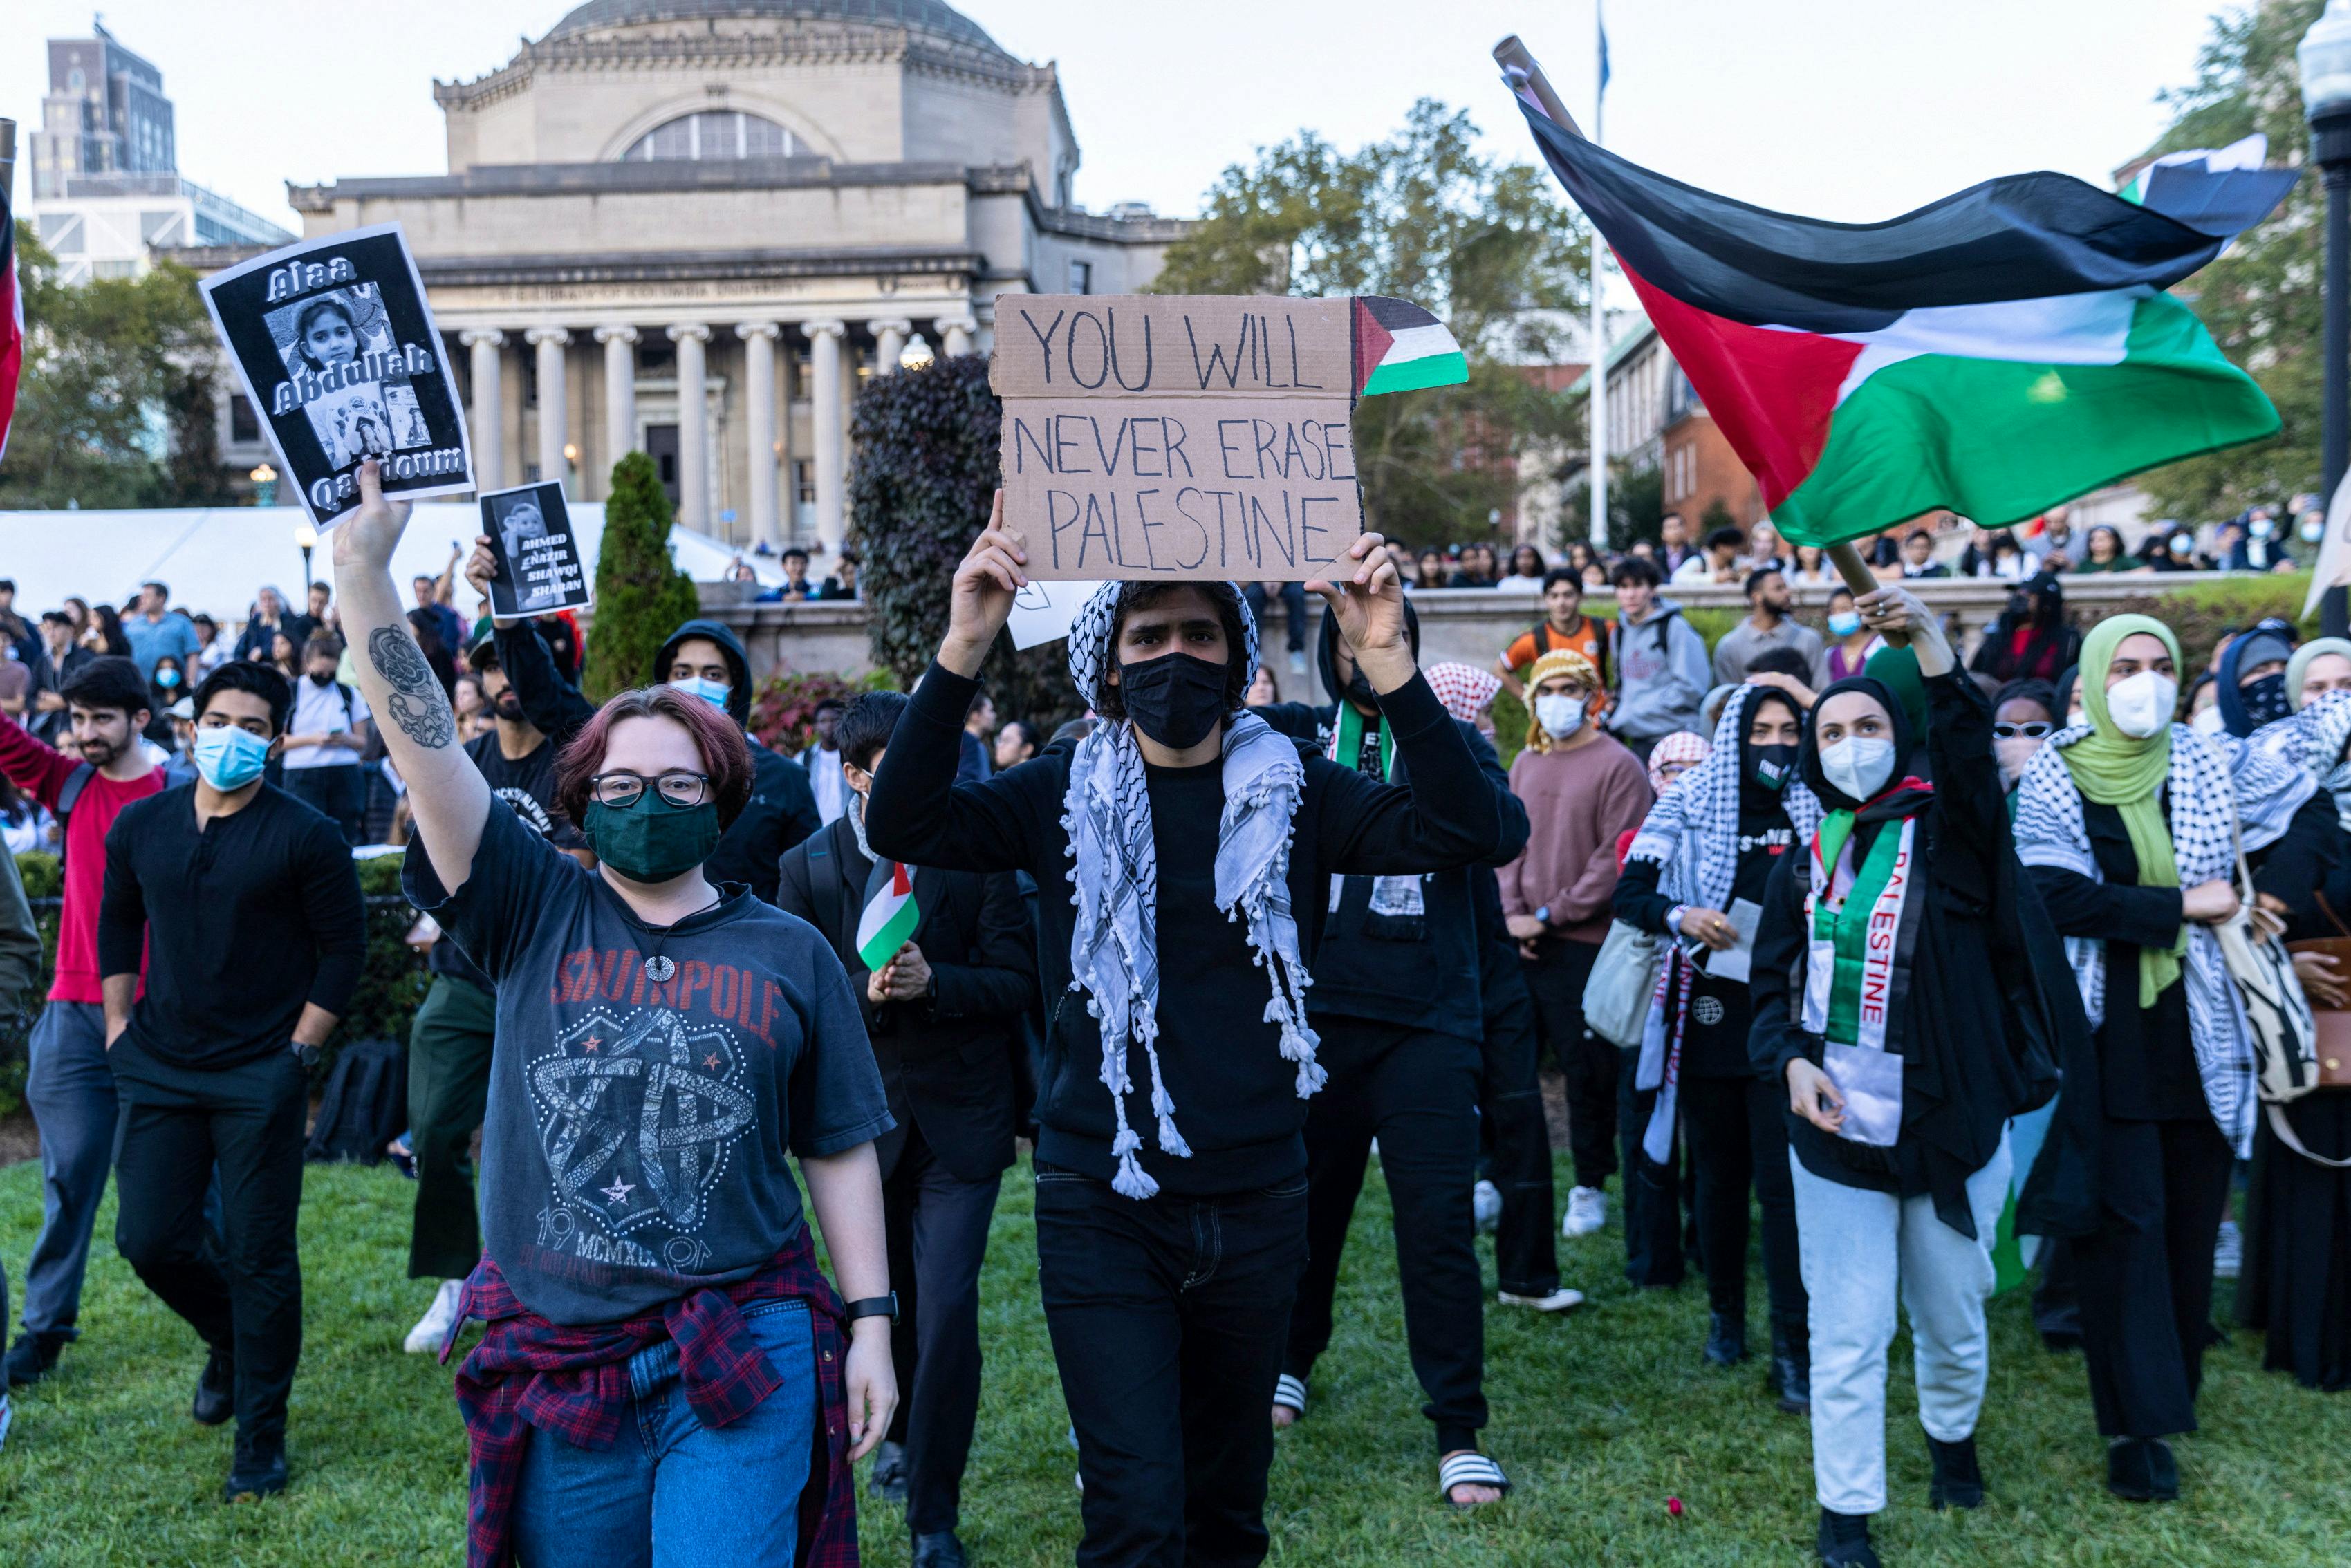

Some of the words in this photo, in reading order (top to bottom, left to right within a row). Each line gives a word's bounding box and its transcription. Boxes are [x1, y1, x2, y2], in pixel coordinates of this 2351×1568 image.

[267, 256, 358, 303] Alaa
[1020, 307, 1151, 391] YOU
[1184, 313, 1323, 389] WILL
[272, 343, 436, 416] Abdullah
[1014, 415, 1194, 478] NEVER
[1218, 419, 1357, 481] ERASE
[522, 533, 567, 551] AHMED
[1046, 486, 1340, 572] PALESTINE
[527, 563, 579, 582] SHAWQI
[530, 549, 568, 567] NAZIR
[532, 579, 582, 598] SHABAN
[537, 1206, 575, 1250] 19
